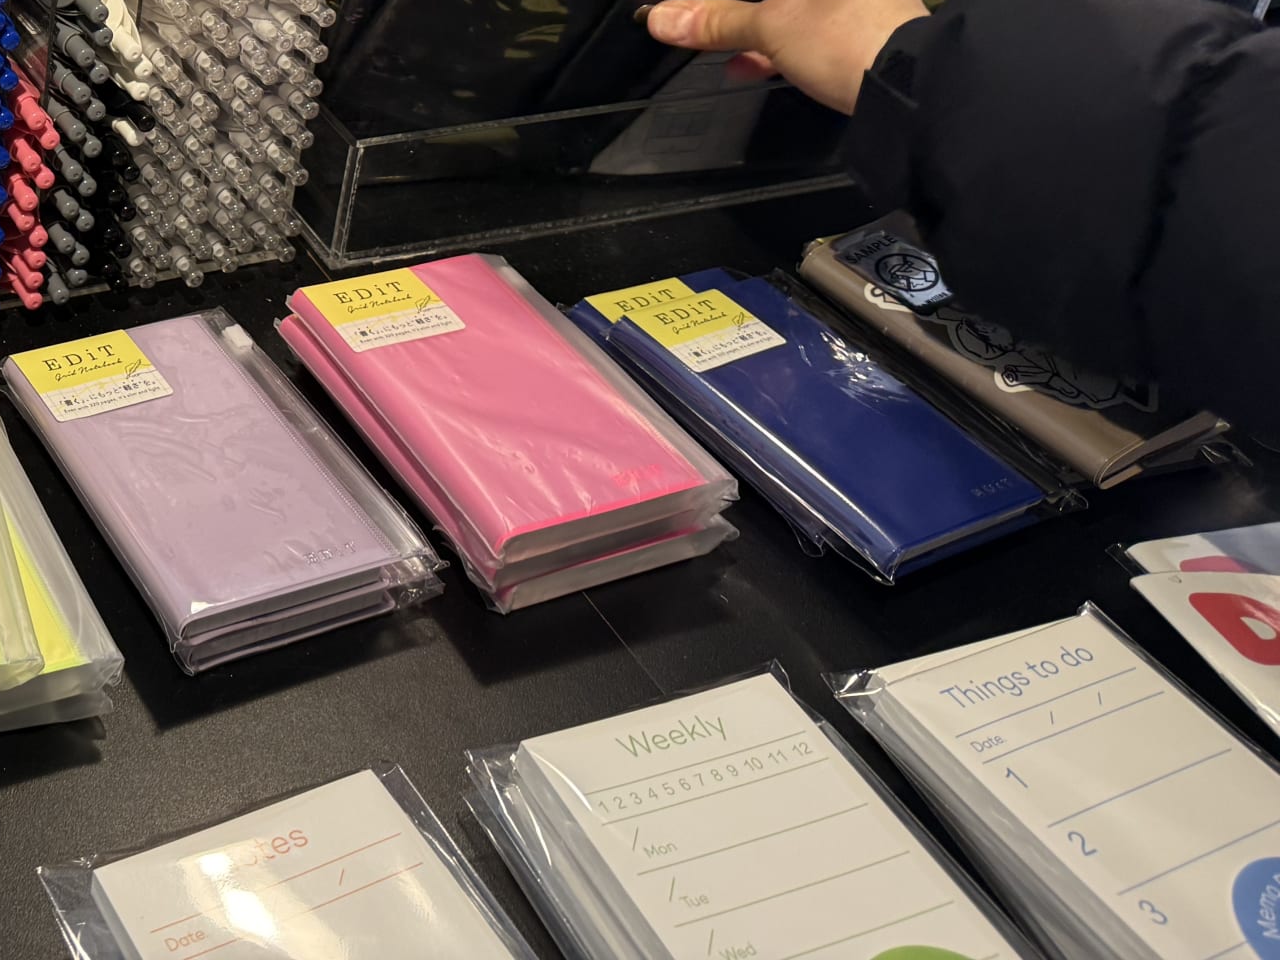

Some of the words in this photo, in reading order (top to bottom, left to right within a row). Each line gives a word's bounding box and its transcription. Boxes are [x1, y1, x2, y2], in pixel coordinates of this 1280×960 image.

[845, 235, 898, 265] SAMPLE
[333, 281, 405, 304] EDiT
[614, 288, 676, 313] EDiT
[654, 299, 717, 326] EDiT
[42, 344, 116, 372] EDiT
[79, 358, 123, 374] Notebook
[940, 670, 1030, 708] Things
[1027, 659, 1059, 679] to
[1061, 646, 1094, 667] do
[615, 715, 727, 758] Weekly
[598, 800, 609, 813] 1
[613, 796, 627, 810] 2
[630, 792, 642, 805] 3
[648, 788, 658, 800] 4
[662, 782, 675, 796] 5
[679, 778, 691, 791] 6
[694, 773, 705, 786] 7
[710, 768, 723, 782] 8
[726, 764, 739, 777] 9
[744, 756, 763, 772] 10
[768, 751, 788, 765] 11
[792, 742, 813, 756] 12
[1005, 767, 1028, 789] 1
[643, 842, 677, 858] Mon
[1067, 831, 1097, 856] 2
[680, 894, 710, 910] Tue
[1138, 899, 1168, 926] 3
[720, 943, 757, 960] Wed
